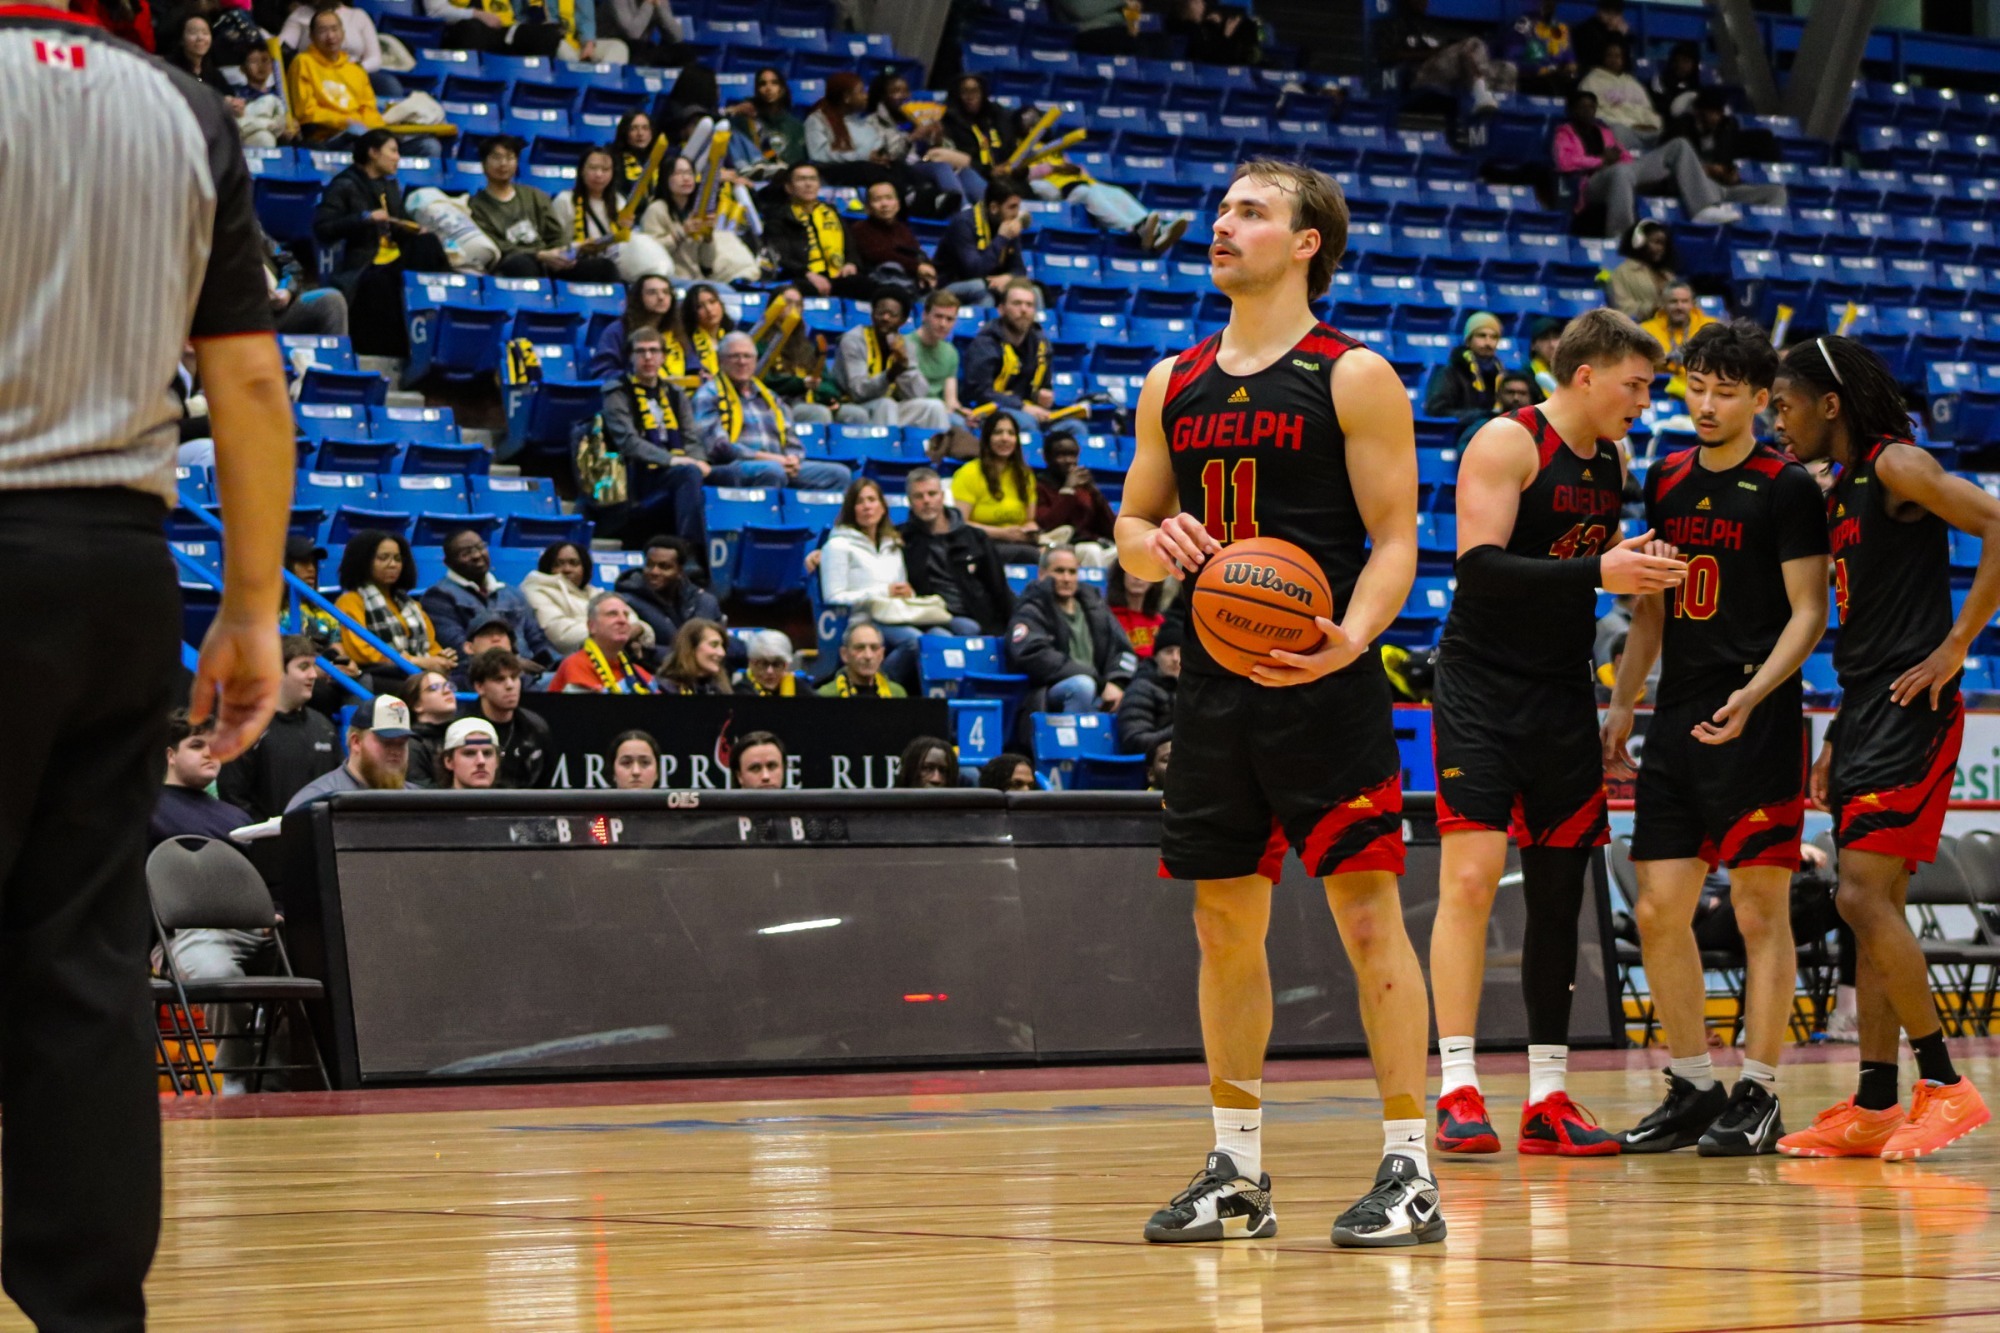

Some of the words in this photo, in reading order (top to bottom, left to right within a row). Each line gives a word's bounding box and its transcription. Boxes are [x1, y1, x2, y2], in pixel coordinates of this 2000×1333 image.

[319, 250, 334, 274] H
[411, 316, 427, 344] G
[508, 391, 522, 419] F
[1172, 410, 1304, 453] GUELPH
[1201, 457, 1259, 543] 11
[1664, 516, 1743, 550] GUELPH
[710, 538, 728, 568] D
[1223, 562, 1313, 607] Wilson
[1674, 553, 1720, 620] 10
[818, 610, 837, 641] C
[1216, 608, 1303, 641] EVOLUTION
[968, 716, 986, 752] 4
[667, 791, 700, 808] OES
[557, 818, 572, 843] B
[610, 818, 624, 843] P
[739, 816, 753, 841] P
[791, 816, 805, 841] B
